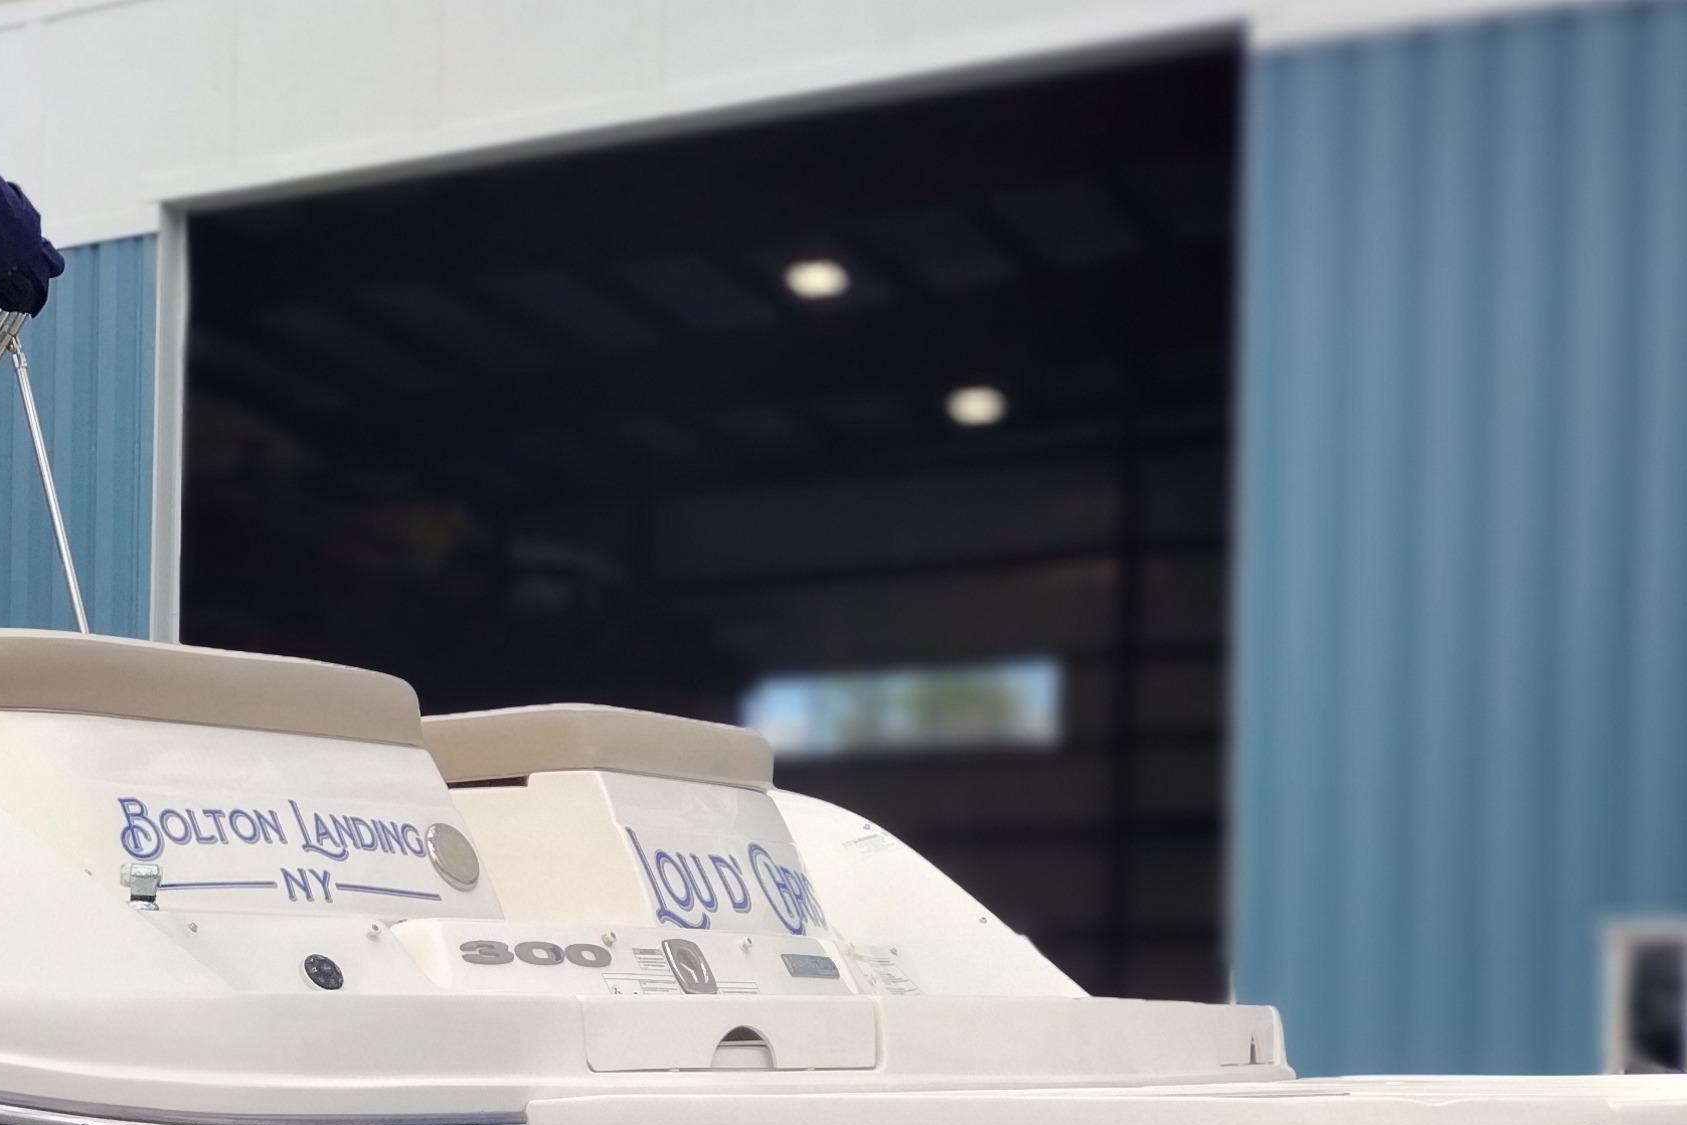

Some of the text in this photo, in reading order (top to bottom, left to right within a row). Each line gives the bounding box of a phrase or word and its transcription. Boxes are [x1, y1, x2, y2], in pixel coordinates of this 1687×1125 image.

[118, 797, 428, 861] BOLTON LANDING
[280, 867, 333, 903] NY
[459, 940, 612, 967] 300
